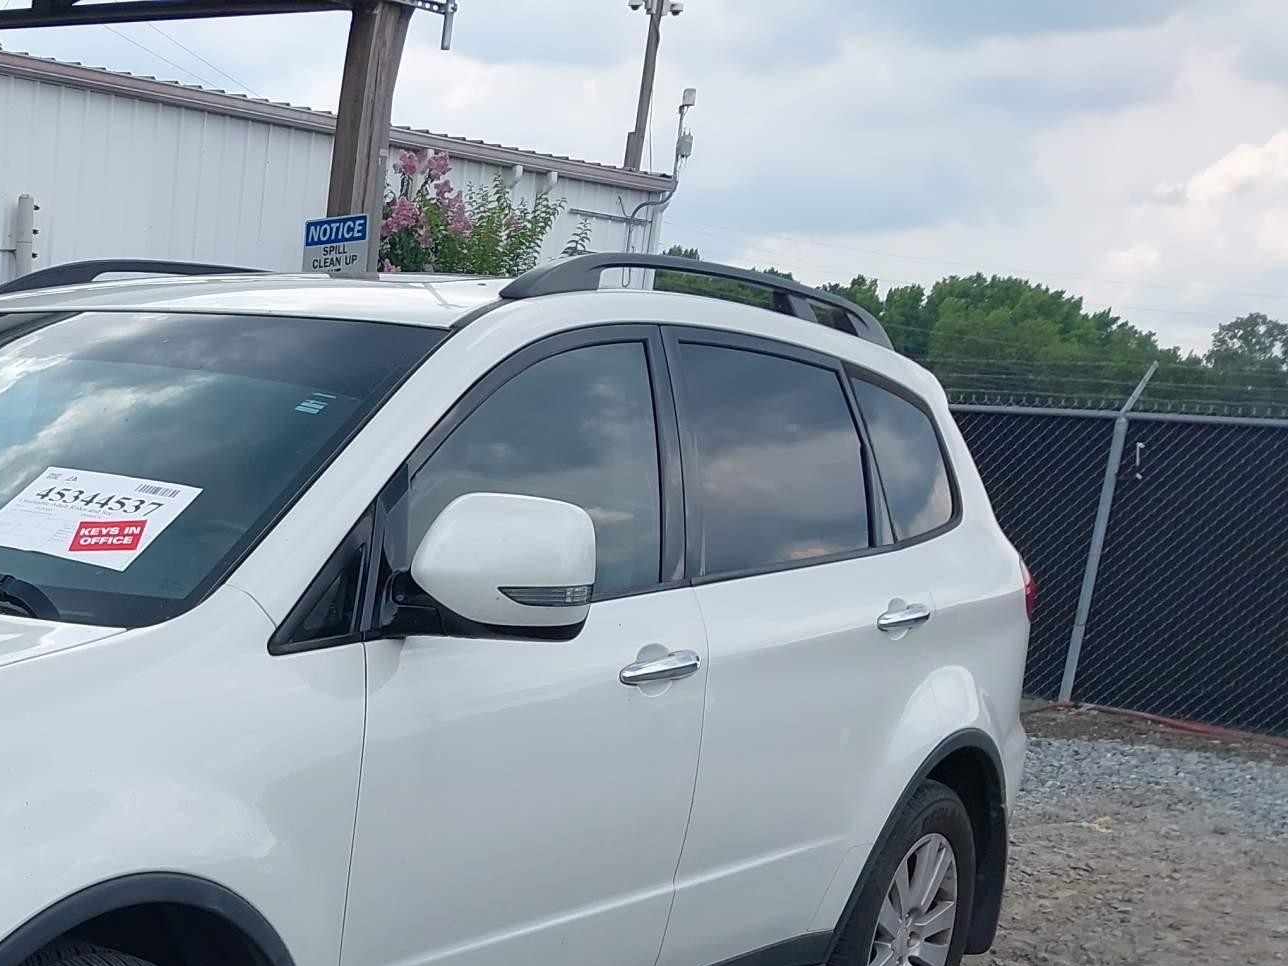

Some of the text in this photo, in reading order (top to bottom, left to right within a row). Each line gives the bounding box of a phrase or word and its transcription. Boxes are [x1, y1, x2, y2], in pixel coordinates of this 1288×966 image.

[308, 219, 365, 243] NOTICE
[322, 244, 348, 256] SPILL
[312, 254, 358, 269] CLEAN UP
[36, 486, 165, 517] 45344537
[79, 526, 142, 536] KEYS IN
[79, 536, 134, 545] OFFICE
